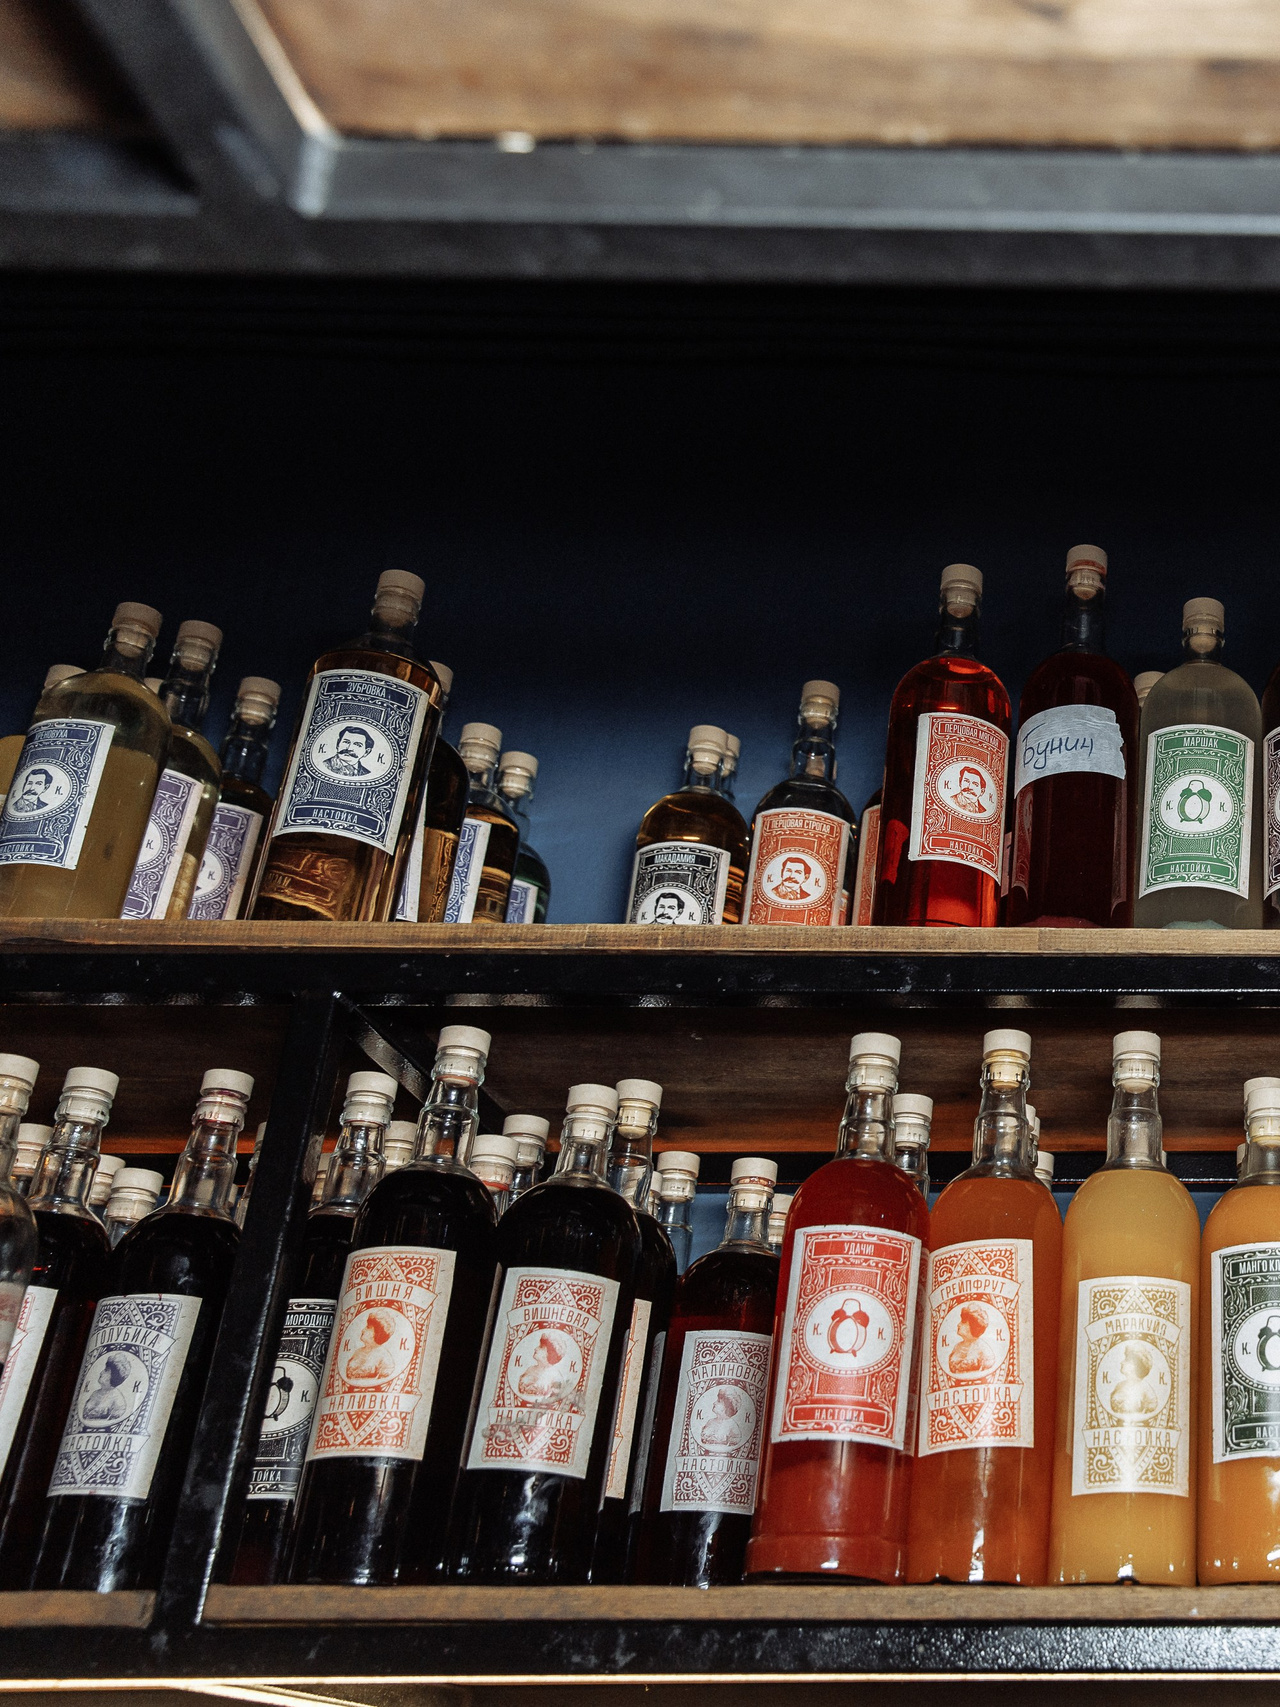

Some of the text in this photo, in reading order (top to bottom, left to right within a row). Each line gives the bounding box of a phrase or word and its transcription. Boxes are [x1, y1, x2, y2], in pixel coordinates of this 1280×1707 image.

[346, 682, 387, 699] ЗУБРОВКА
[944, 723, 1000, 748] ПЕРЦОВАЯ МЯГКАЯ
[1182, 735, 1220, 749] МАРШАК
[312, 808, 358, 825] НАСТОЙКА
[770, 818, 832, 834] ПЕРЦОВАЯ СТРОГАЯ
[949, 839, 984, 859] НАСТОЙКА
[654, 853, 696, 865] МАКАДАМИЯ
[1169, 862, 1212, 874] НАСТОЙКА
[843, 1242, 875, 1256] УДАЧИ!
[1239, 1260, 1269, 1275] МАНГО
[355, 1285, 414, 1302] ВИШНЯ
[940, 1281, 1007, 1301] ГРЕЙПФРУТ
[285, 1314, 334, 1327] МОРОДИНА
[523, 1305, 590, 1331] ВИШНЁВАЯ
[1104, 1316, 1168, 1338] МАРАКУЙЯ
[94, 1327, 158, 1349] ГОЛУБИКА
[691, 1365, 766, 1388] МАЛИНОВКА
[328, 1394, 400, 1412] НАЛИВКА
[933, 1385, 1013, 1407] НАСТОЙКА
[1092, 1426, 1172, 1447] НАСОЙКА
[252, 1467, 282, 1483] ТОЙКА
